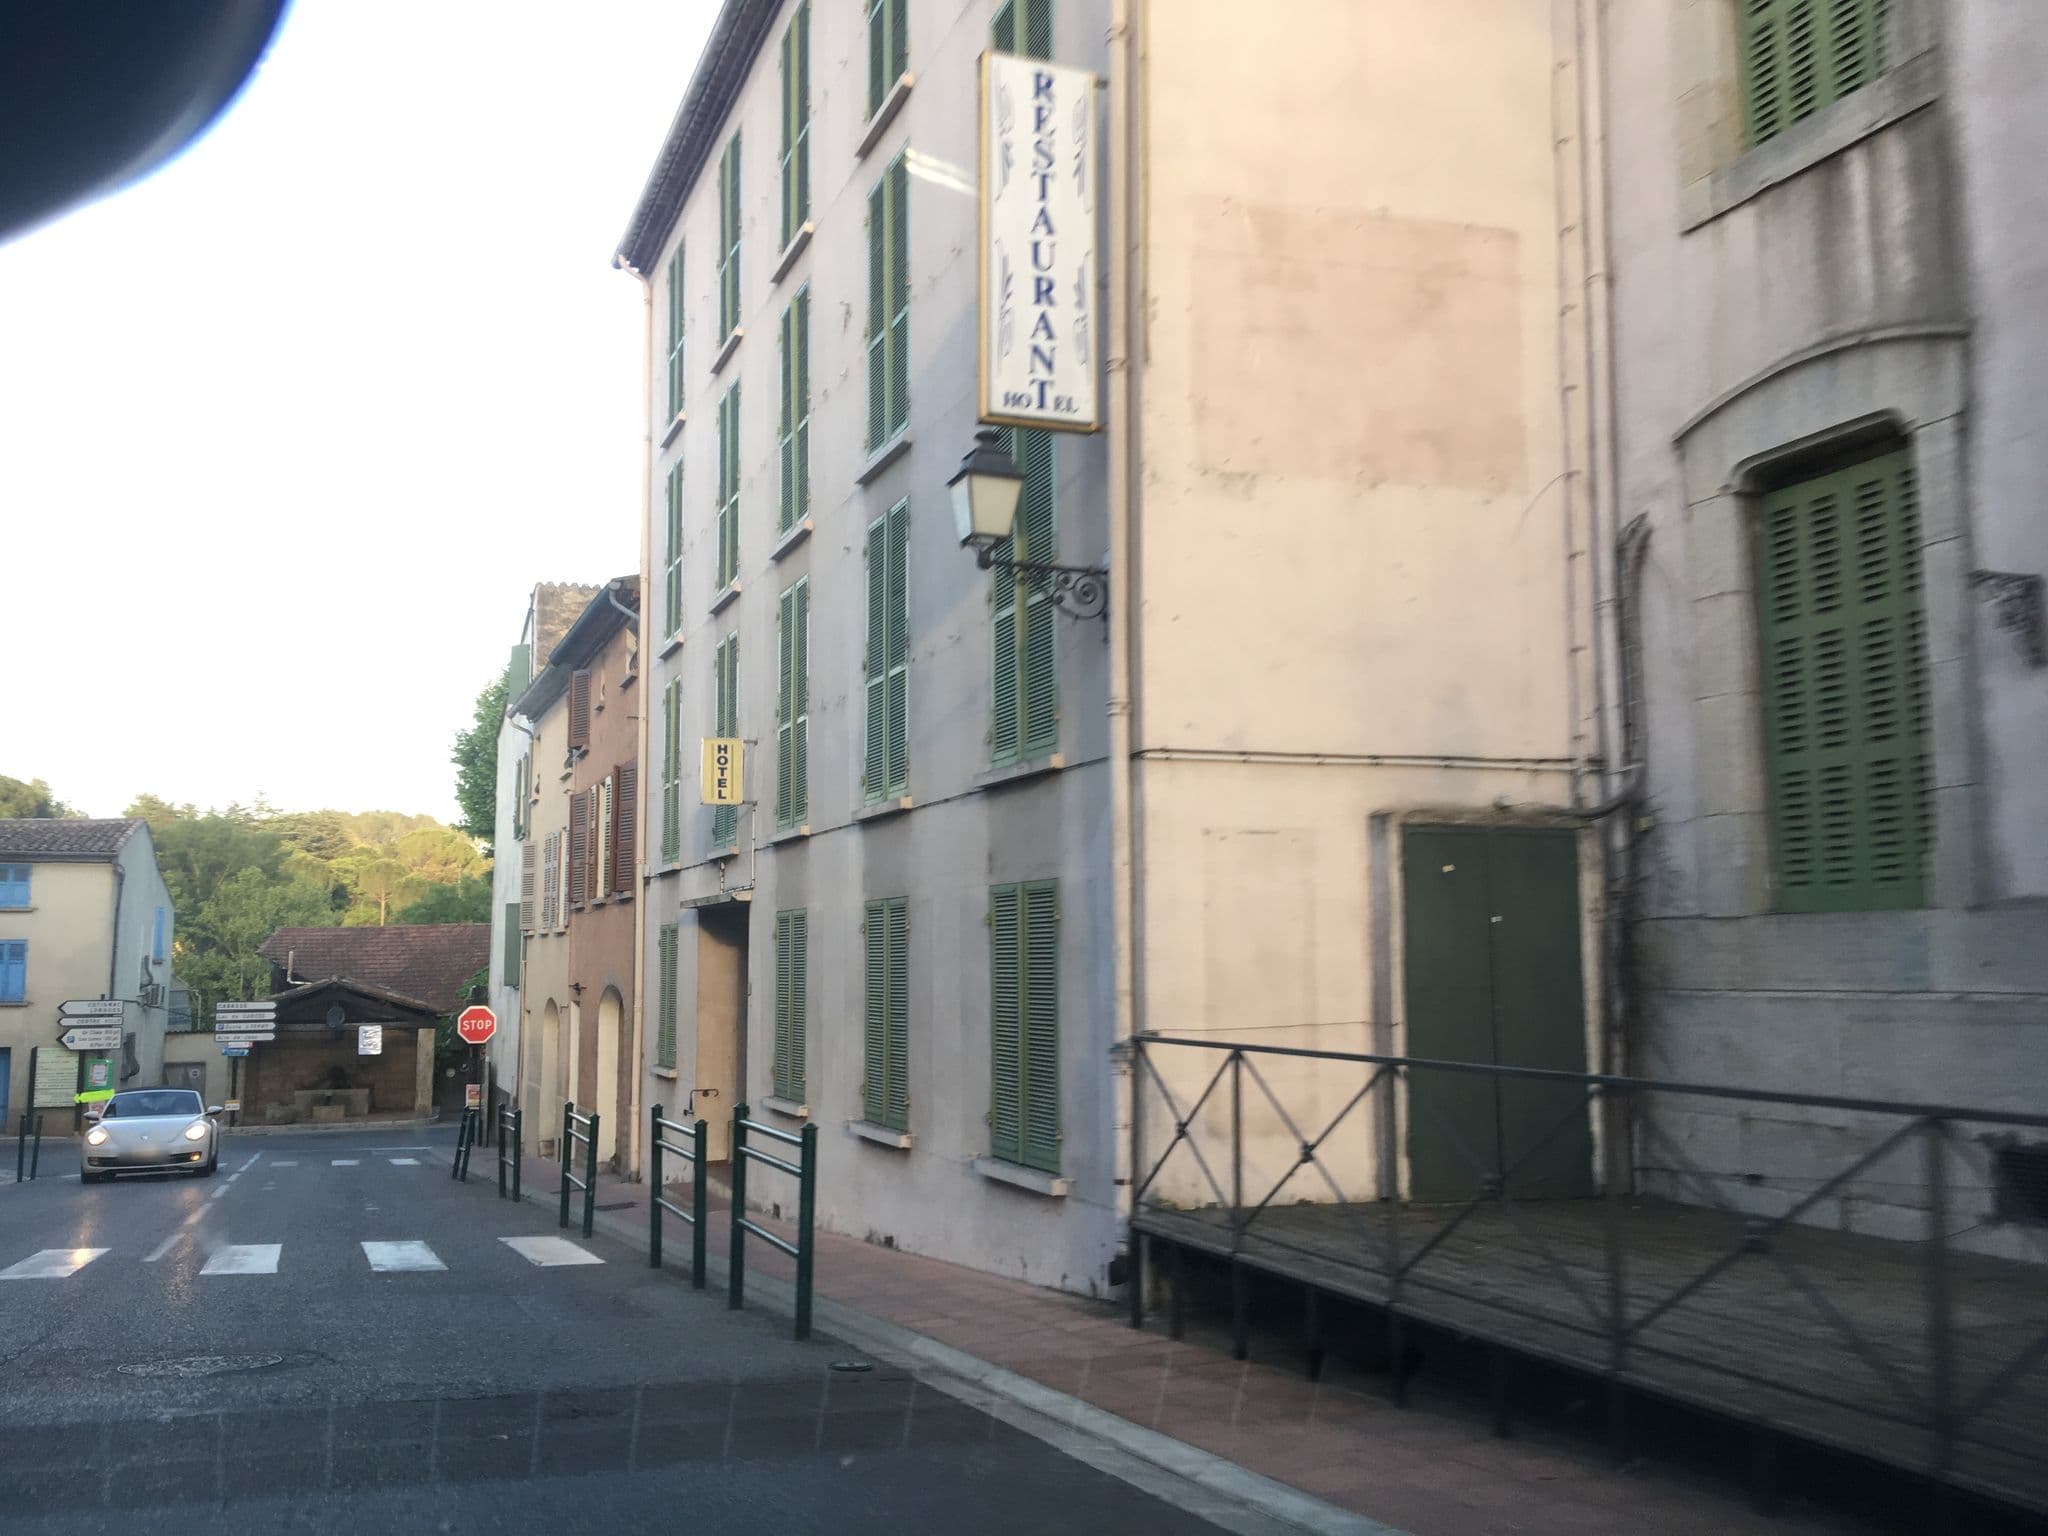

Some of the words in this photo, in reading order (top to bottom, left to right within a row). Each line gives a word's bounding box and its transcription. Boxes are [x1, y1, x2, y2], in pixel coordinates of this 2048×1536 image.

[1029, 71, 1058, 409] RESTAURANT
[716, 743, 729, 800] HOTEL
[462, 1019, 493, 1031] STOP
